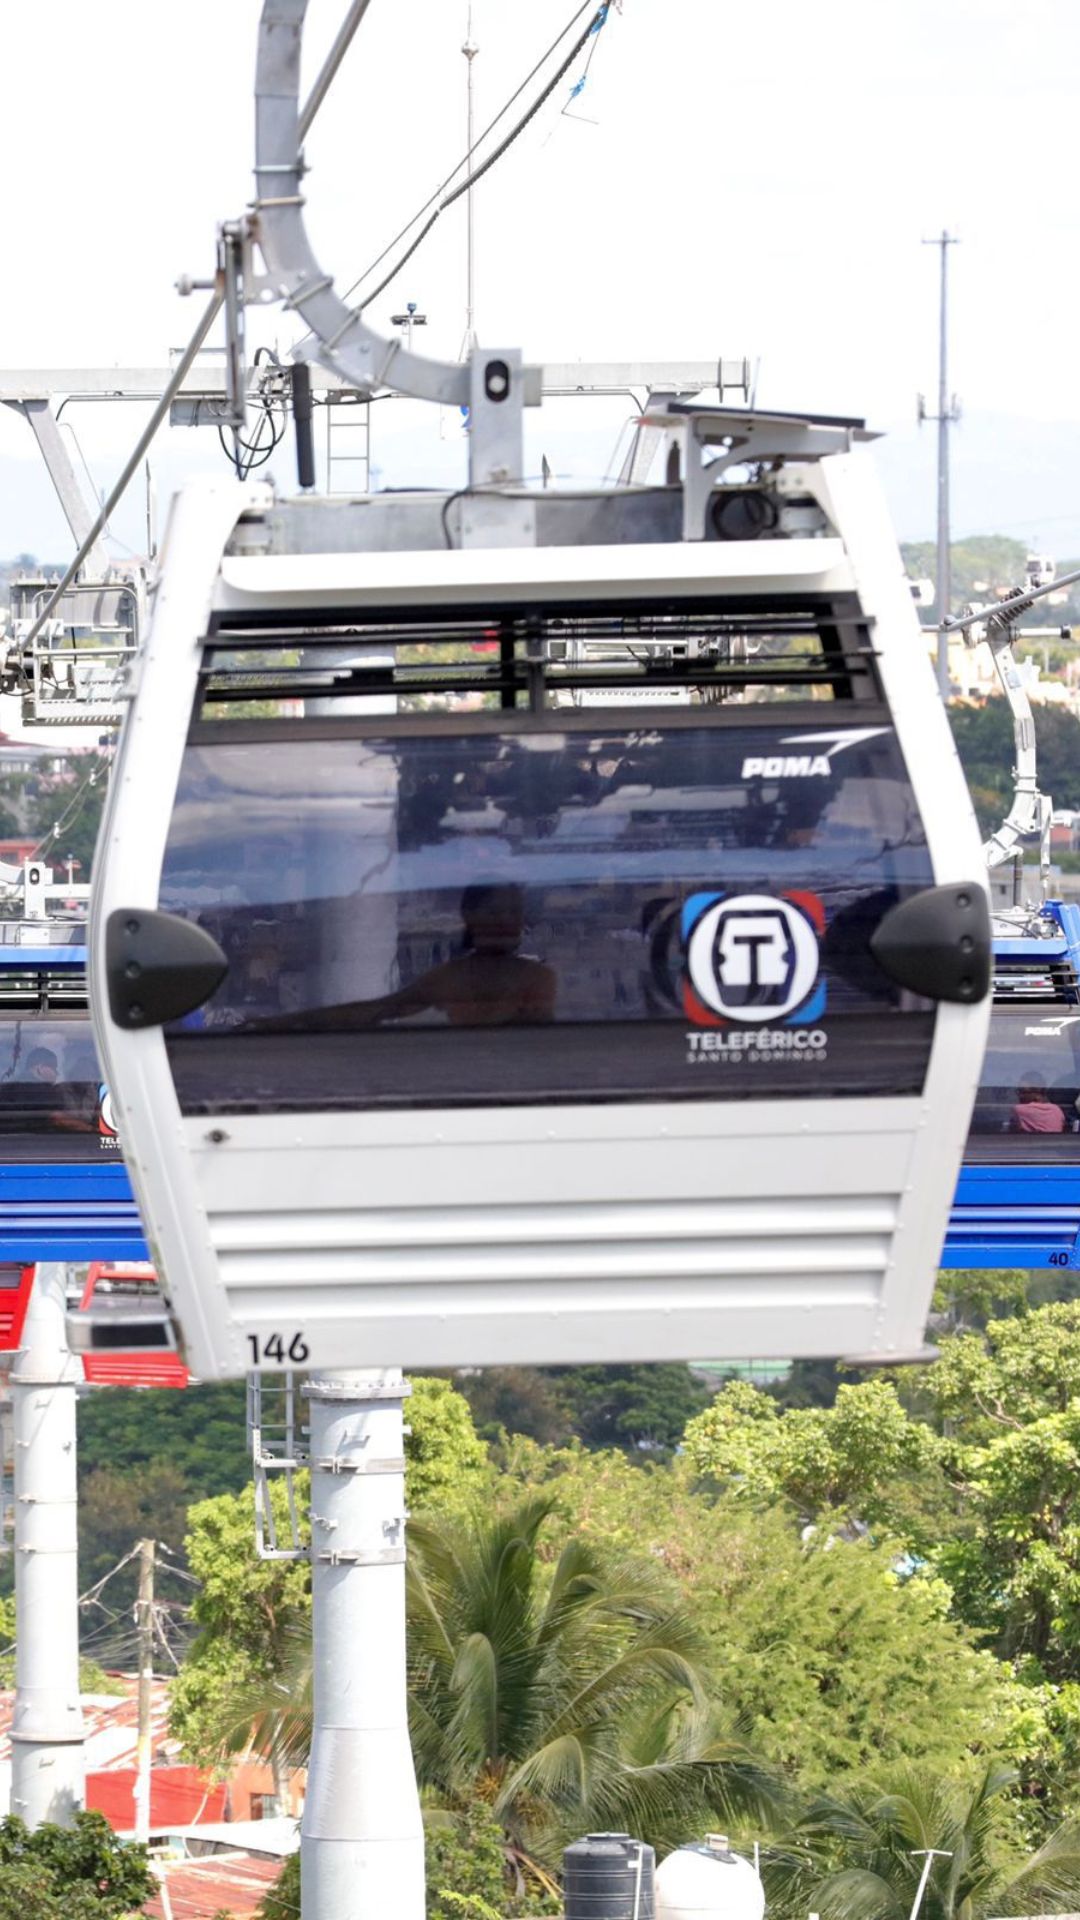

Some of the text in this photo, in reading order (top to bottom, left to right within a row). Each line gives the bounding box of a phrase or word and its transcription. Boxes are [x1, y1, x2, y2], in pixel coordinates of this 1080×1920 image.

[741, 754, 832, 780] POMA
[685, 1026, 828, 1052] TELEFÉRICO
[685, 1049, 828, 1064] SANTO DOMINGO
[1048, 1252, 1069, 1266] 40
[247, 1331, 310, 1365] 146
